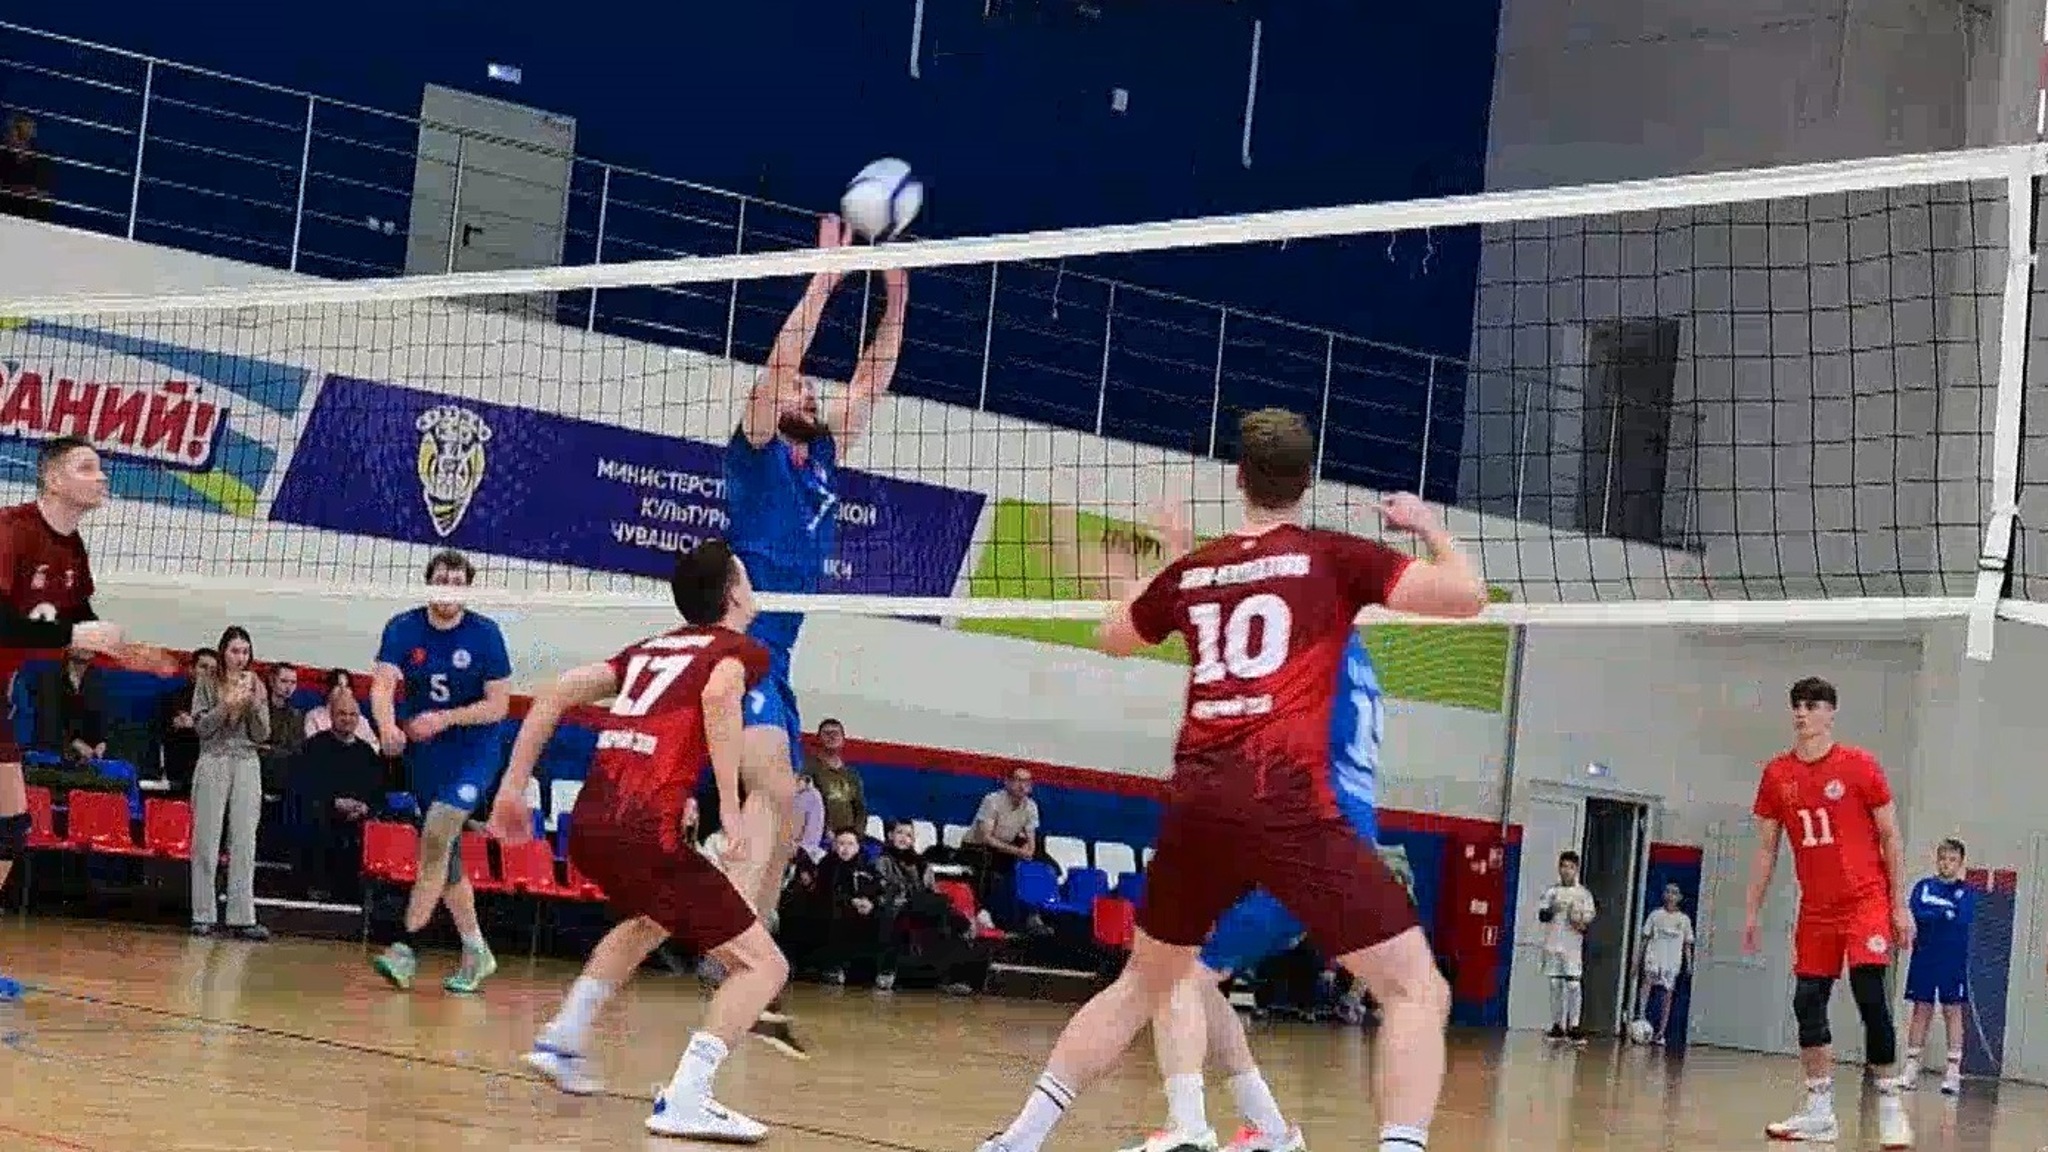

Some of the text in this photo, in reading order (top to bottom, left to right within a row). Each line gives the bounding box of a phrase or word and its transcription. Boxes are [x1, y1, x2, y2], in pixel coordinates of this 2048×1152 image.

[0, 370, 215, 458] АНИЙ!
[597, 457, 727, 499] МИНИСТЕРСТ
[1187, 593, 1293, 684] 10
[430, 673, 450, 702] 5
[609, 654, 696, 716] 17
[1797, 807, 1835, 847] 11
